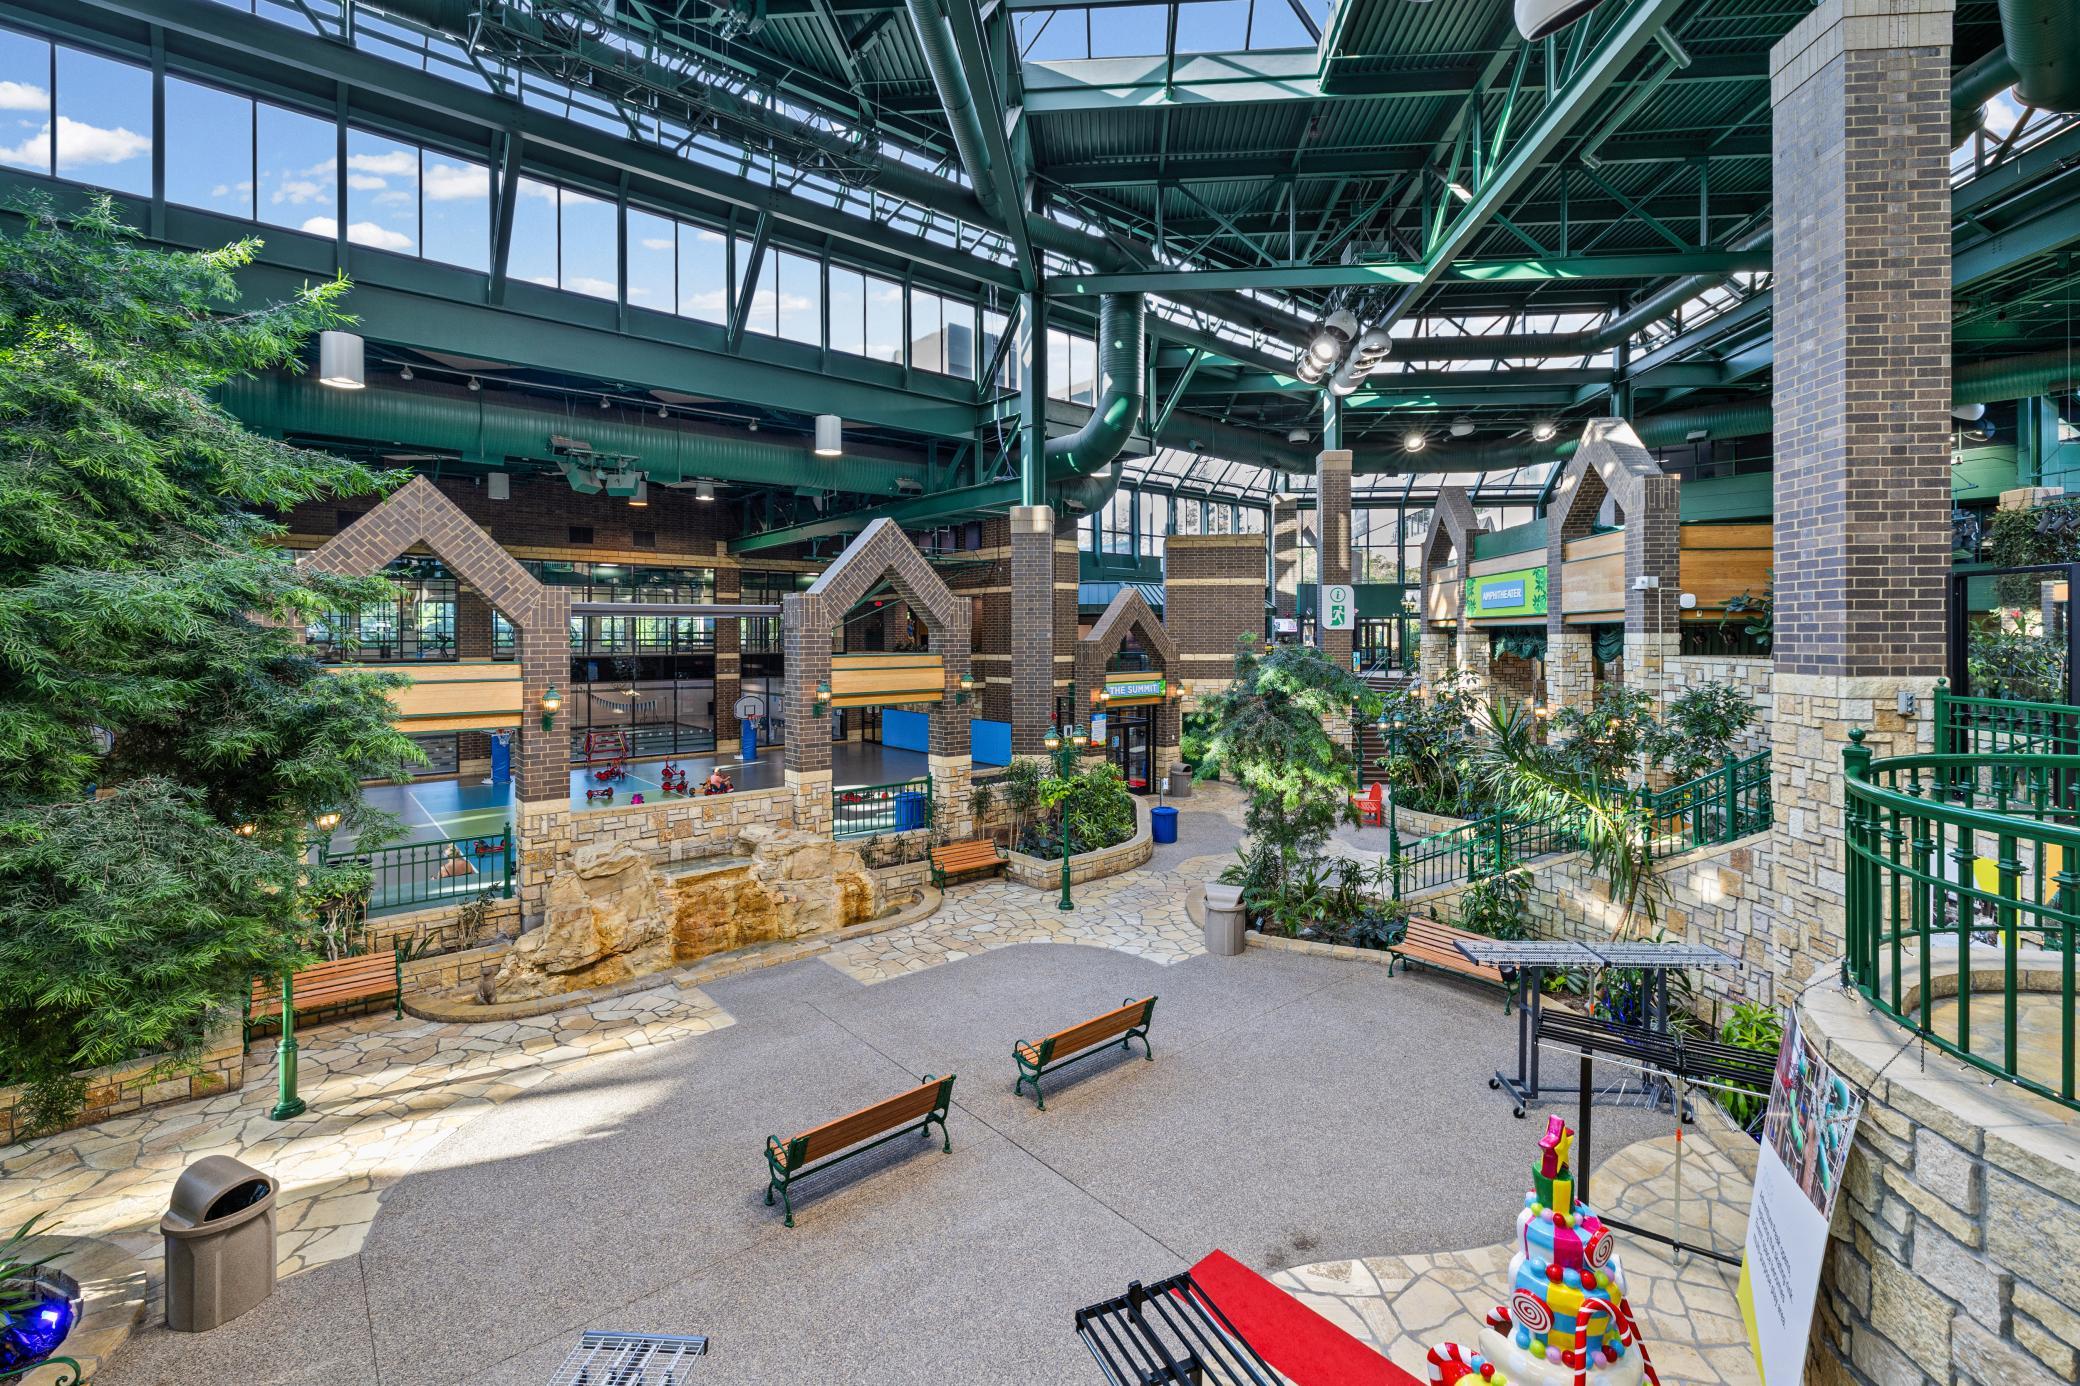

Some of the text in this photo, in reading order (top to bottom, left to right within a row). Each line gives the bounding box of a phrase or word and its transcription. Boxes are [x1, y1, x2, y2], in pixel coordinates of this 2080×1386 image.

[1483, 588, 1521, 600] AMPHITHEATER
[1109, 684, 1157, 695] THE SUMMIT
